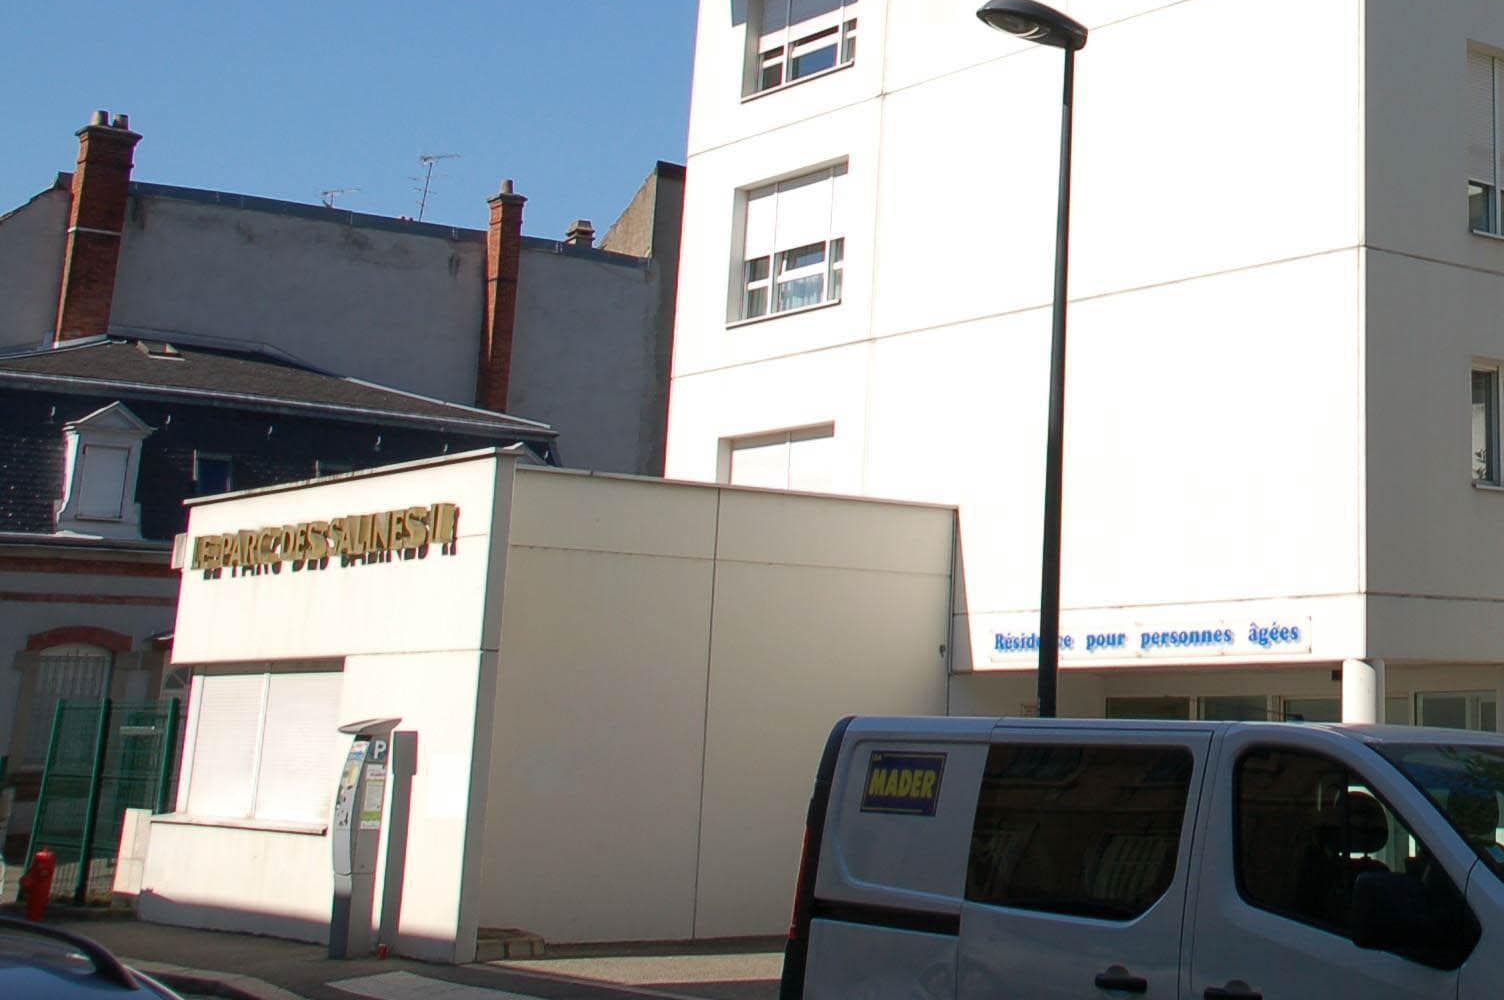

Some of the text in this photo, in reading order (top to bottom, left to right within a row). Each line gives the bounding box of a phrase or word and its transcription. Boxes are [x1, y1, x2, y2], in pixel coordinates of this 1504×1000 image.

[221, 529, 279, 567] PARC
[279, 520, 330, 561] DES
[327, 506, 428, 556] SALINES
[1086, 633, 1126, 650] pour
[1141, 628, 1233, 649] personnes
[1248, 622, 1300, 646] âgées
[373, 740, 387, 760] P
[869, 768, 937, 799] MADER
